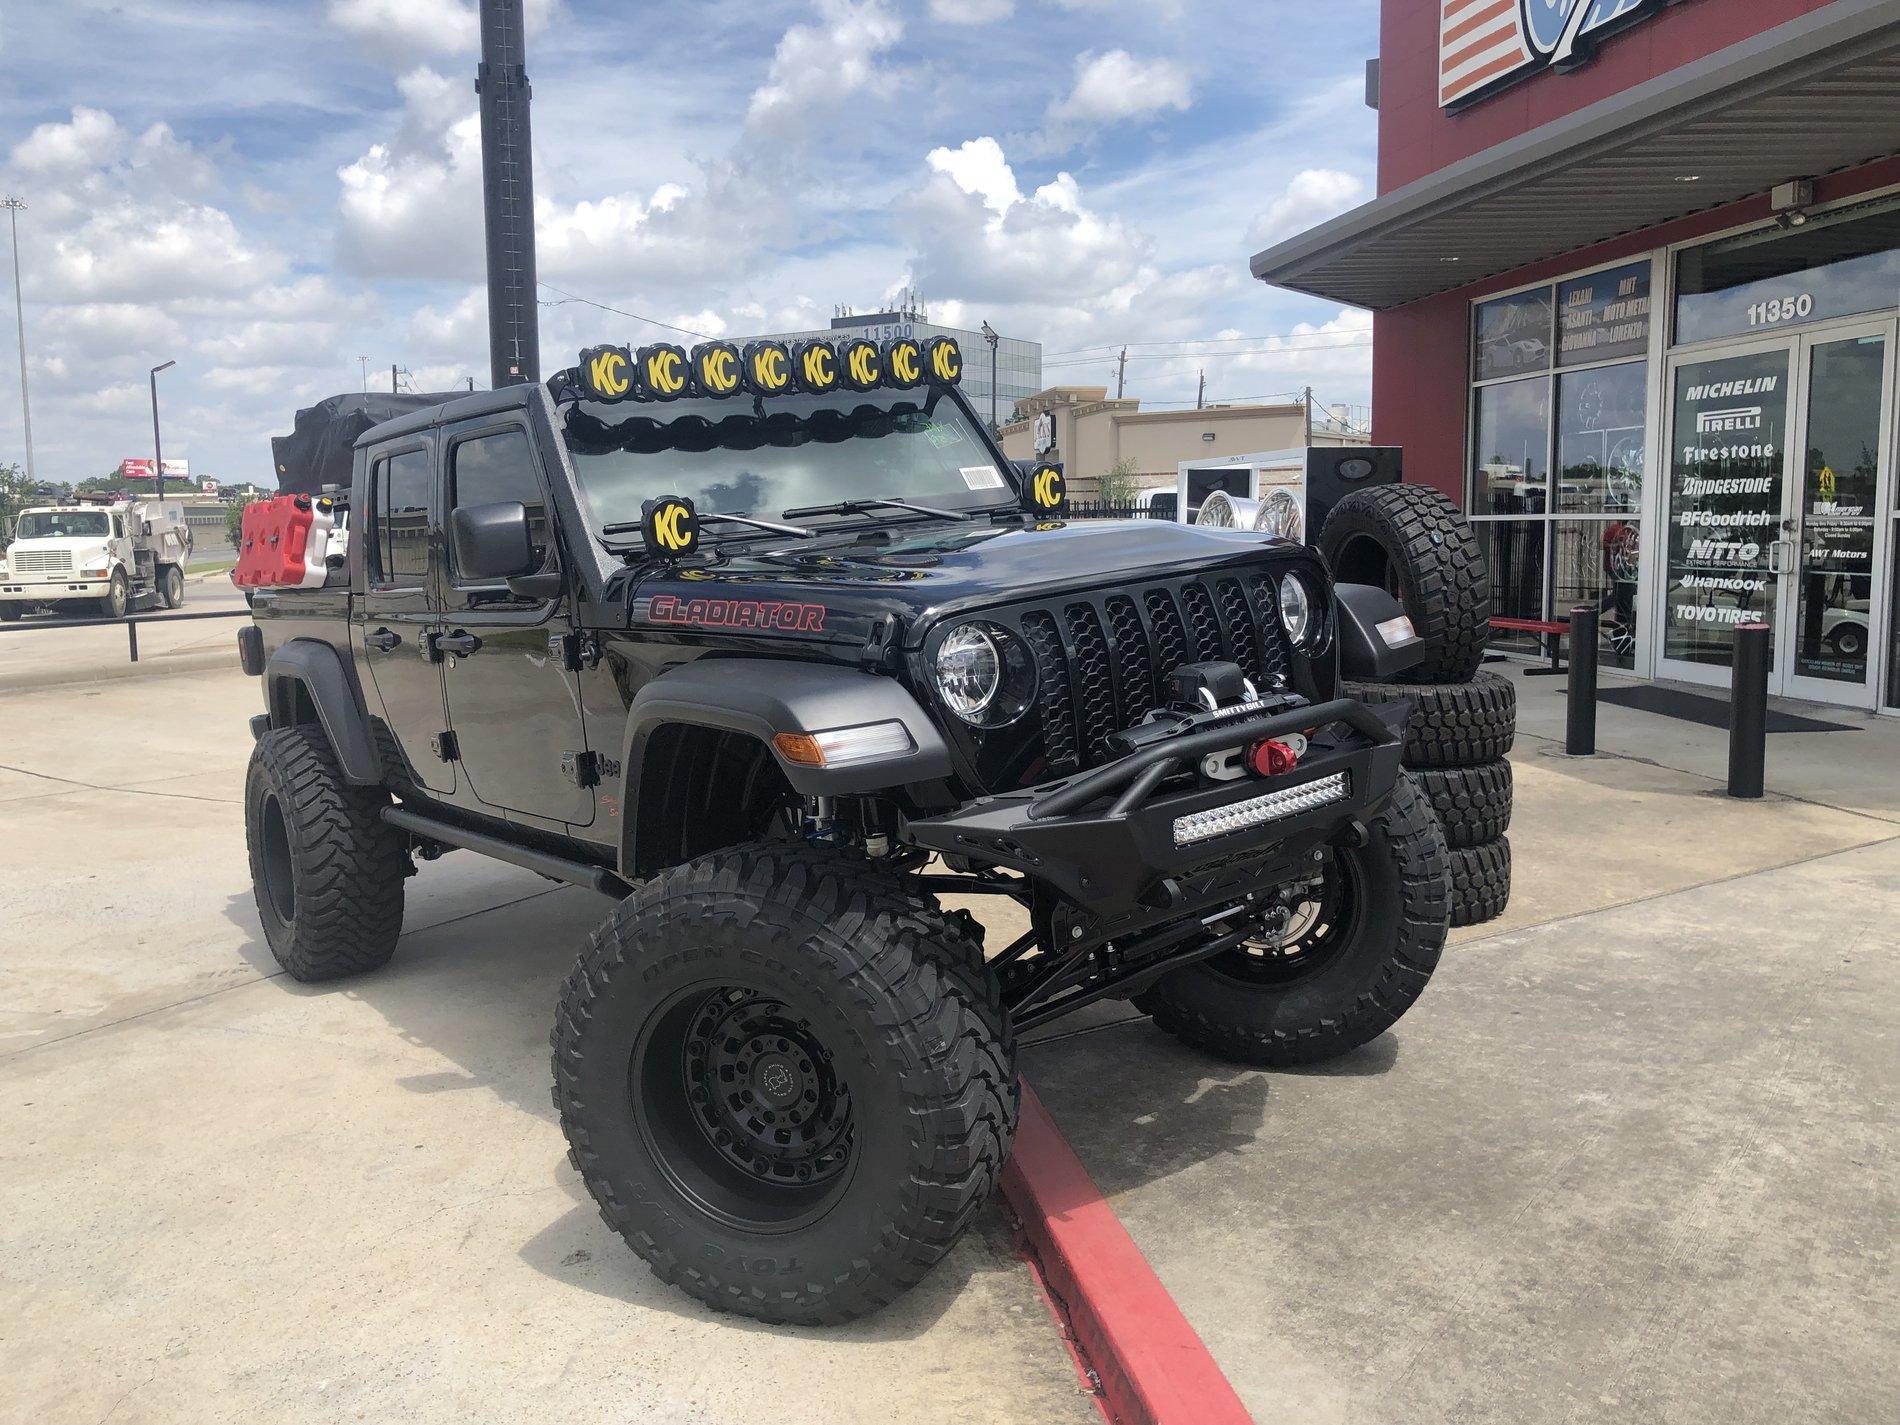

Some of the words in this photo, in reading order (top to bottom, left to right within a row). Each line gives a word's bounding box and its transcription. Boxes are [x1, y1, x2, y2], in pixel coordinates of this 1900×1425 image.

[1747, 294, 1812, 325] 11350
[863, 323, 913, 341] 11500
[1609, 321, 1644, 344] LORENZO
[593, 355, 626, 394] KC
[648, 352, 682, 390] KC
[703, 351, 736, 389] KC
[755, 348, 785, 390] KC
[804, 346, 833, 387] KC
[849, 345, 877, 385] KC
[893, 344, 918, 383] KC
[932, 342, 957, 379] KC
[1685, 376, 1778, 401] MICHELIN
[1696, 406, 1762, 433] PIRELLI
[1683, 443, 1774, 466] Firestone
[1034, 470, 1062, 508] KC
[1682, 477, 1772, 496] BRIDGESTONE
[654, 504, 693, 550] KC
[1680, 510, 1771, 526] BFGoodrich
[1686, 539, 1759, 561] NITTO
[1809, 549, 1829, 558] AWT
[1832, 549, 1868, 559] Motors
[648, 595, 826, 632] GLADIATOR
[1212, 700, 1265, 719] SMITTYBILT
